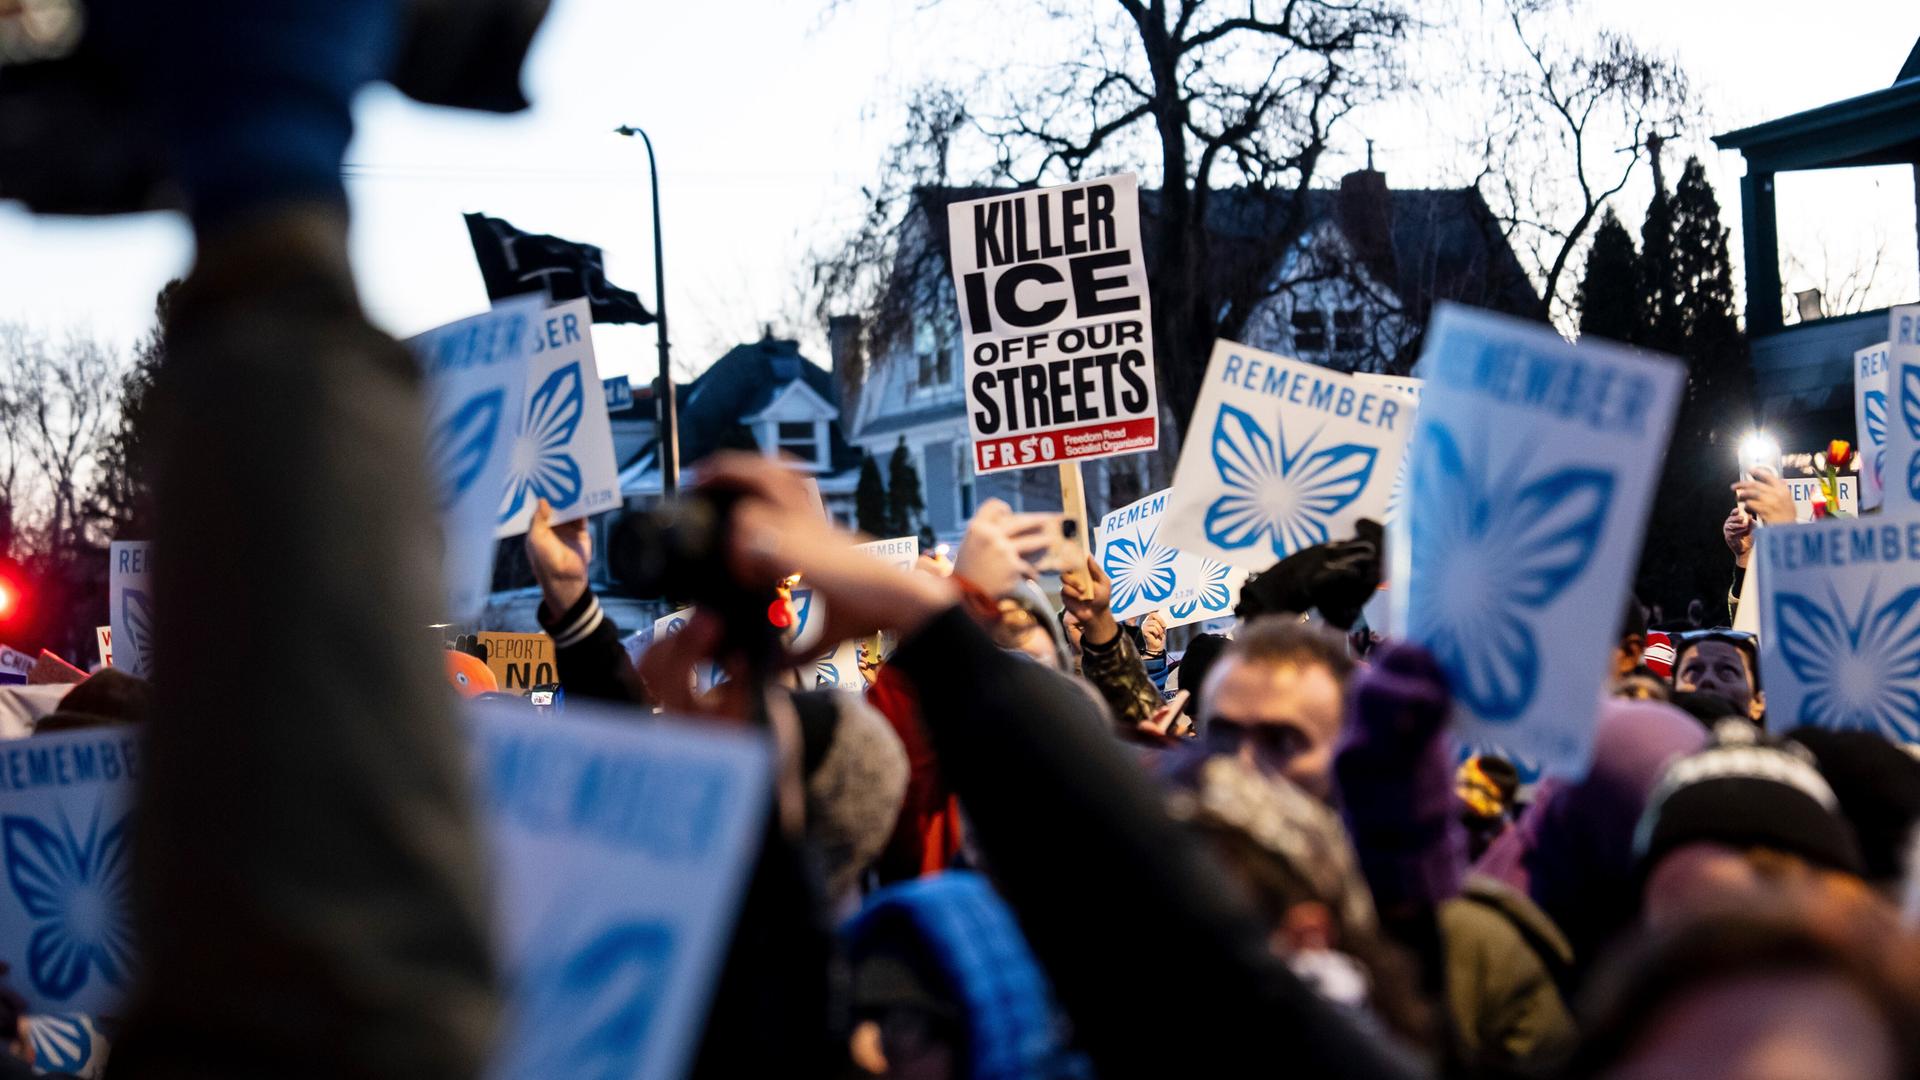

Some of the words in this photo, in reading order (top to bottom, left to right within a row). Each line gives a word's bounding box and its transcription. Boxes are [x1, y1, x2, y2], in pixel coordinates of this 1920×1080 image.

[974, 184, 1116, 269] KILLER
[964, 250, 1140, 334] ICE
[973, 334, 1050, 366] OFF
[1057, 320, 1143, 354] OUR
[972, 349, 1149, 435] STREETS
[1221, 354, 1400, 431] REMEMBER
[981, 436, 1056, 469] FRSO
[1063, 431, 1103, 446] Freedom
[1103, 427, 1126, 439] Road
[1065, 442, 1102, 457] Socialist
[484, 639, 545, 659] DEPORT
[506, 662, 552, 689] NO
